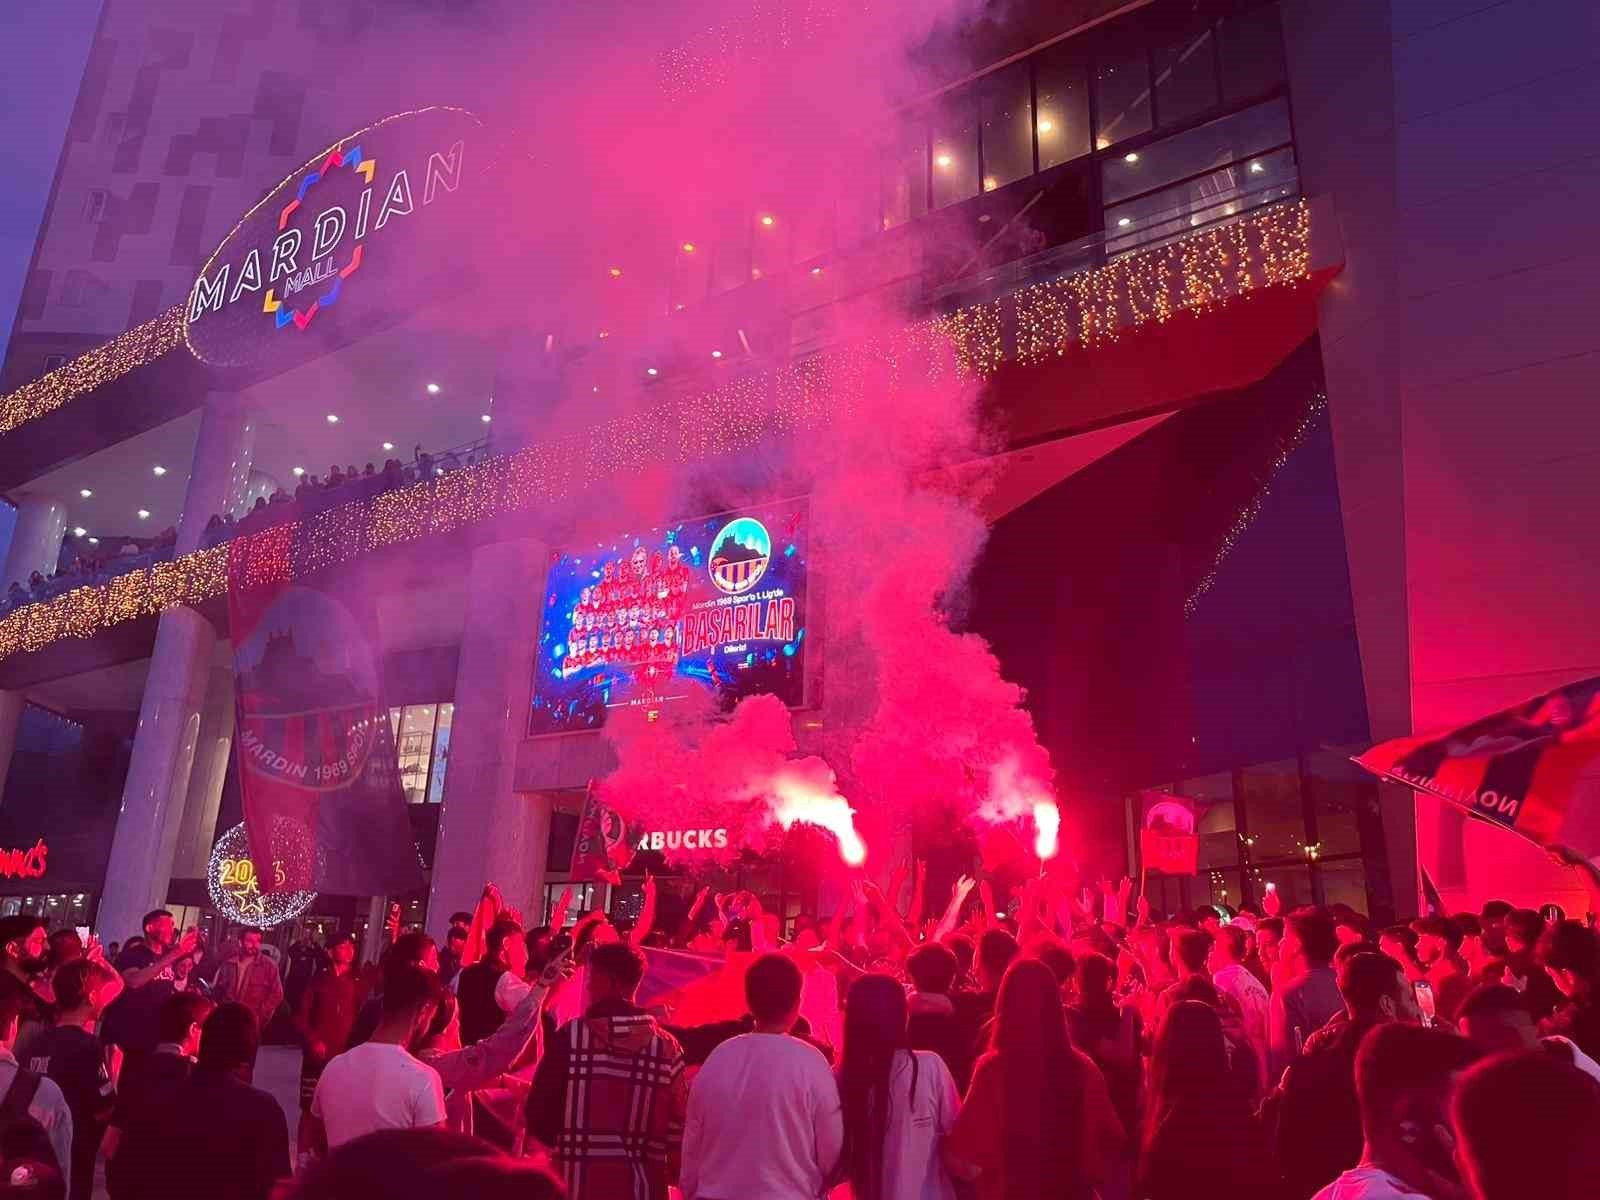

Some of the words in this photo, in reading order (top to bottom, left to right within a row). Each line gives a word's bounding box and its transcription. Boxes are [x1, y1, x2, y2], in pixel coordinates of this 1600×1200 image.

[189, 141, 465, 323] MARDIAN
[283, 256, 338, 297] MALL
[682, 598, 795, 656] BAŞARILAR
[241, 729, 308, 778] MARDIN
[637, 828, 728, 850] RBUCKS
[220, 859, 286, 886] 203
